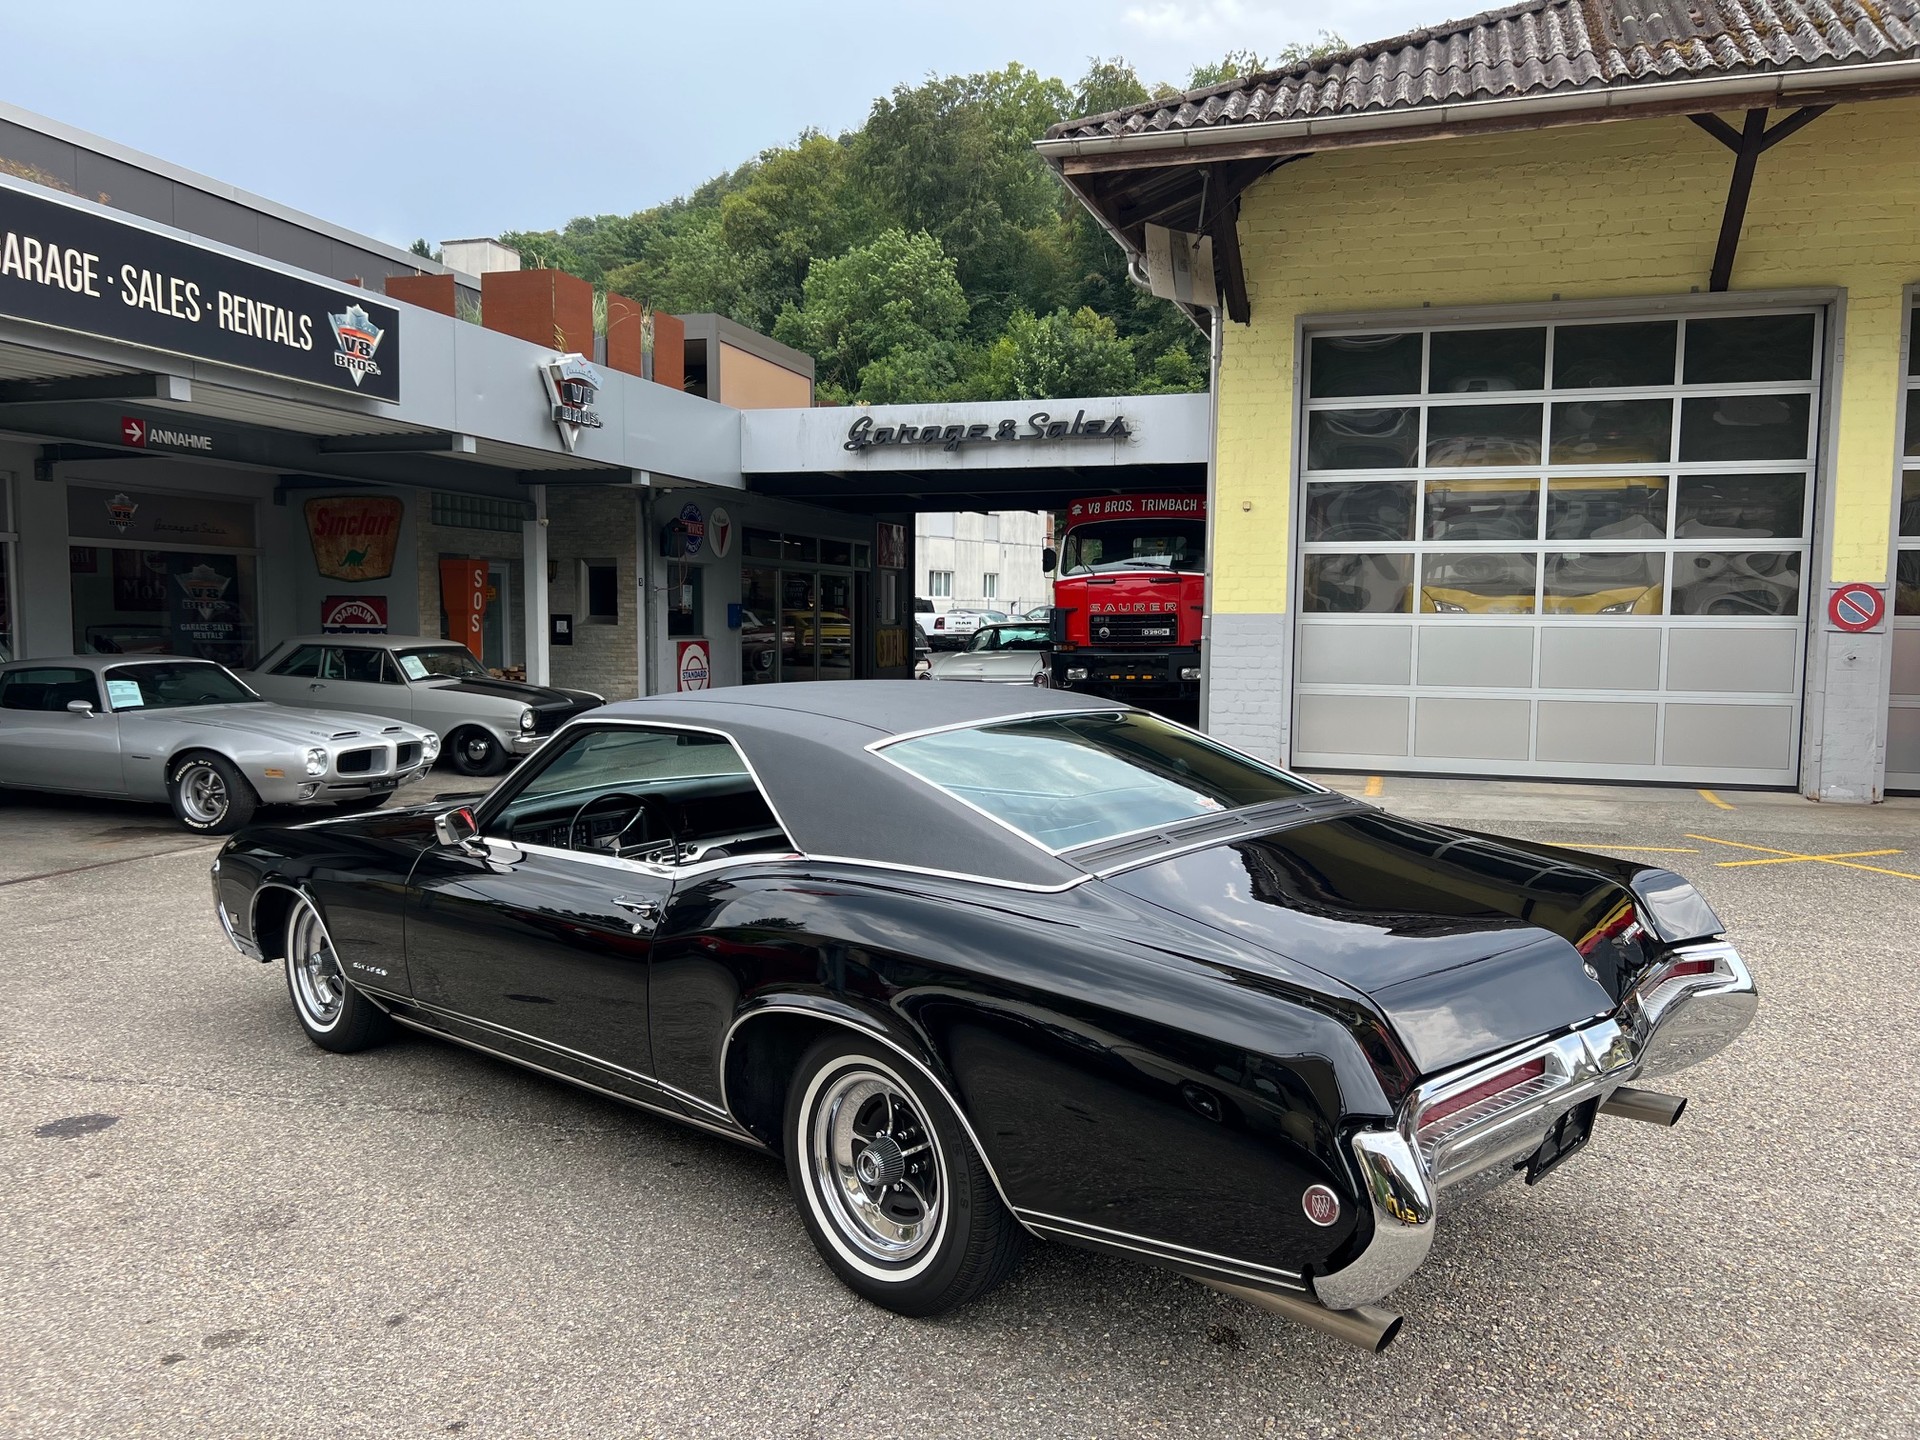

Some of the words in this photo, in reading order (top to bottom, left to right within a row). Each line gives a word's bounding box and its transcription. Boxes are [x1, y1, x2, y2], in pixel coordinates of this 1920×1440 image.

[0, 232, 100, 298] ARAGE
[120, 264, 201, 323] SALES
[218, 290, 313, 351] RENTALS
[342, 334, 371, 358] V8
[334, 352, 381, 375] BROS.
[150, 428, 213, 450] ANNAHME
[844, 415, 991, 451] Garage
[995, 419, 1017, 441] &
[1020, 409, 1132, 441] Sales
[113, 510, 132, 520] V8
[1088, 502, 1101, 514] V8
[1104, 500, 1135, 512] BROS.
[1141, 499, 1198, 511] TRIMBACH
[314, 507, 395, 537] Sinclair
[191, 587, 220, 599] V8
[334, 605, 374, 624] DAPOLIN
[1089, 602, 1178, 613] SAURER
[682, 670, 708, 680] STANDARD
[175, 761, 197, 782] RADIAL
